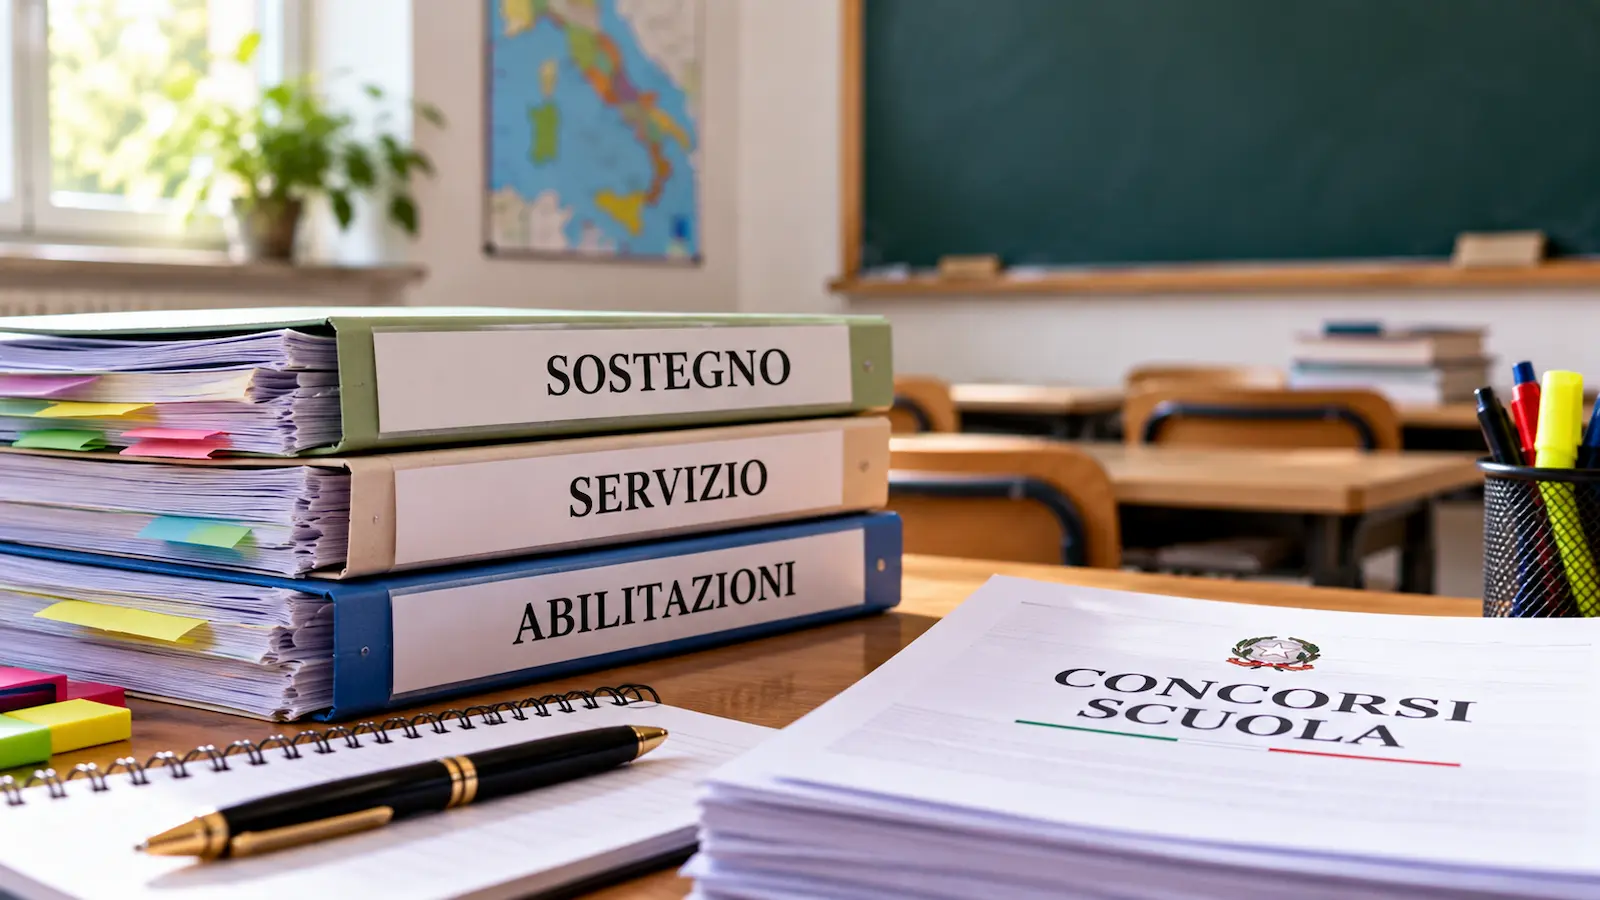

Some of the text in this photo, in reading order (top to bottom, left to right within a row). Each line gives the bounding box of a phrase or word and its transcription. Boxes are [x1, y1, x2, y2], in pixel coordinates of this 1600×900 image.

[545, 348, 792, 397] SOSTEGNO
[568, 459, 769, 518] SERVIZIO
[512, 560, 797, 646] ABILITAZIONI
[1054, 668, 1477, 723] CONCORSI
[1076, 698, 1405, 748] SCUOLA
